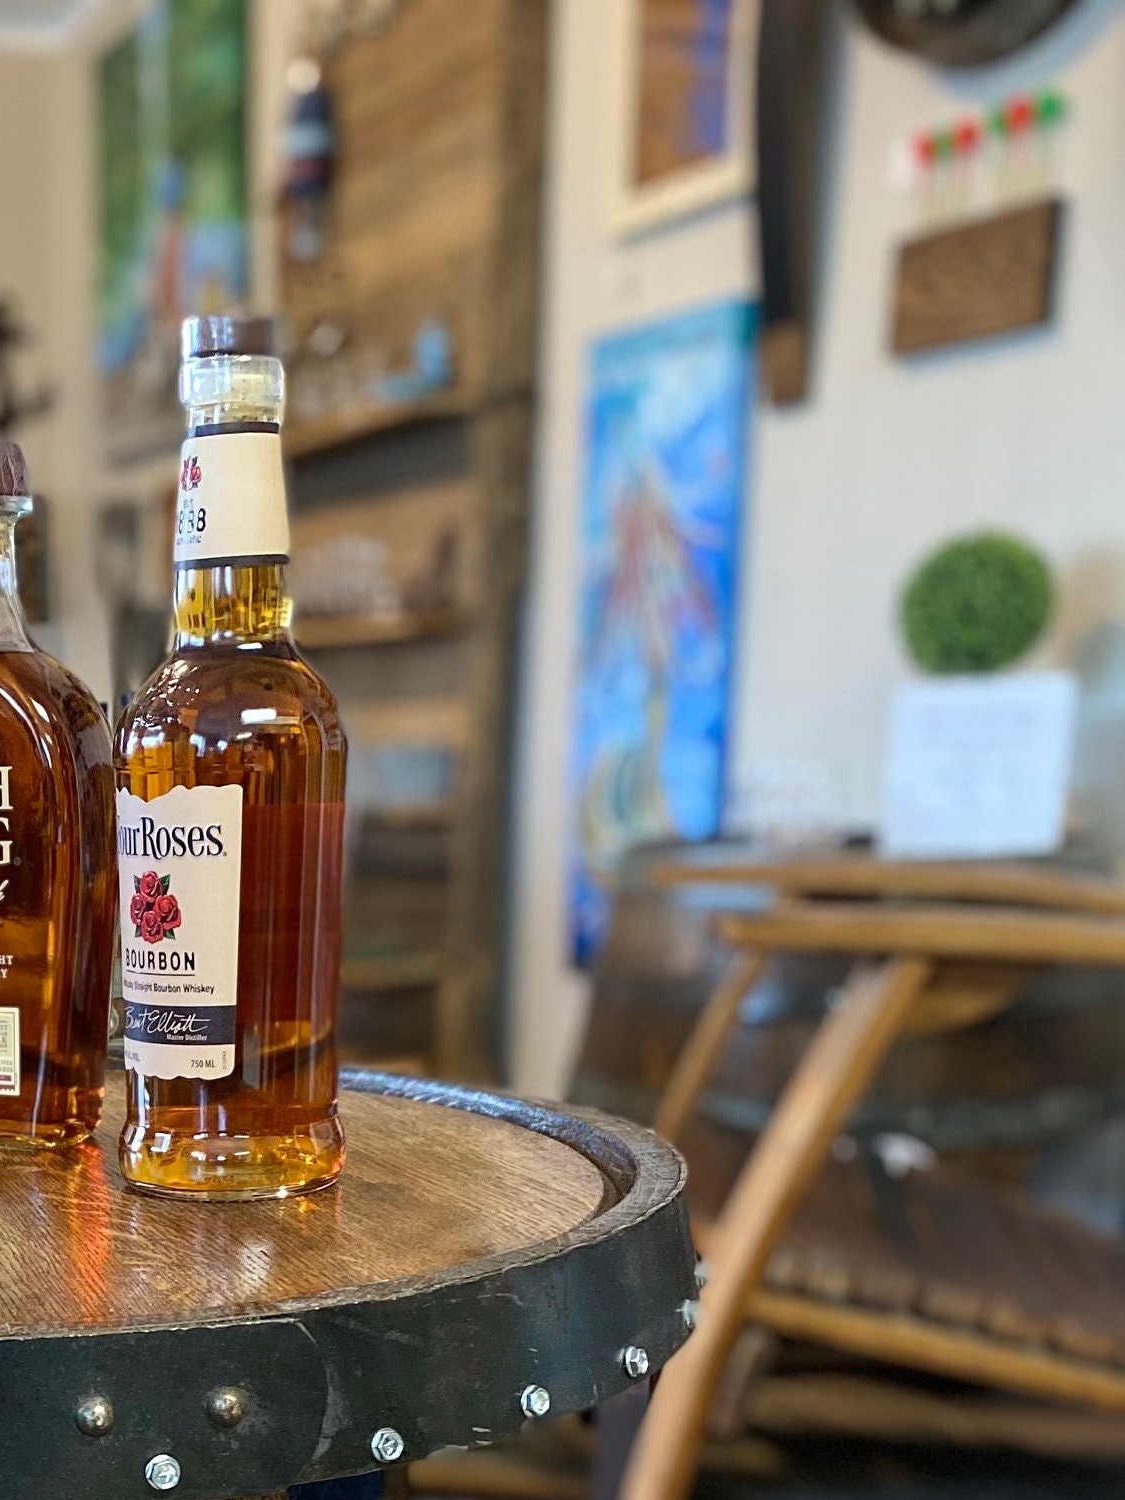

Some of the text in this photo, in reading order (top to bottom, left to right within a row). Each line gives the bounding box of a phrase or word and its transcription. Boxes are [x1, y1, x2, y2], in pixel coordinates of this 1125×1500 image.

[140, 816, 224, 860] Roses
[125, 948, 195, 971] BOURBON
[153, 983, 182, 994] Bourbon
[183, 983, 215, 995] Whiskey
[191, 1059, 204, 1068] 750
[205, 1060, 216, 1068] ML
